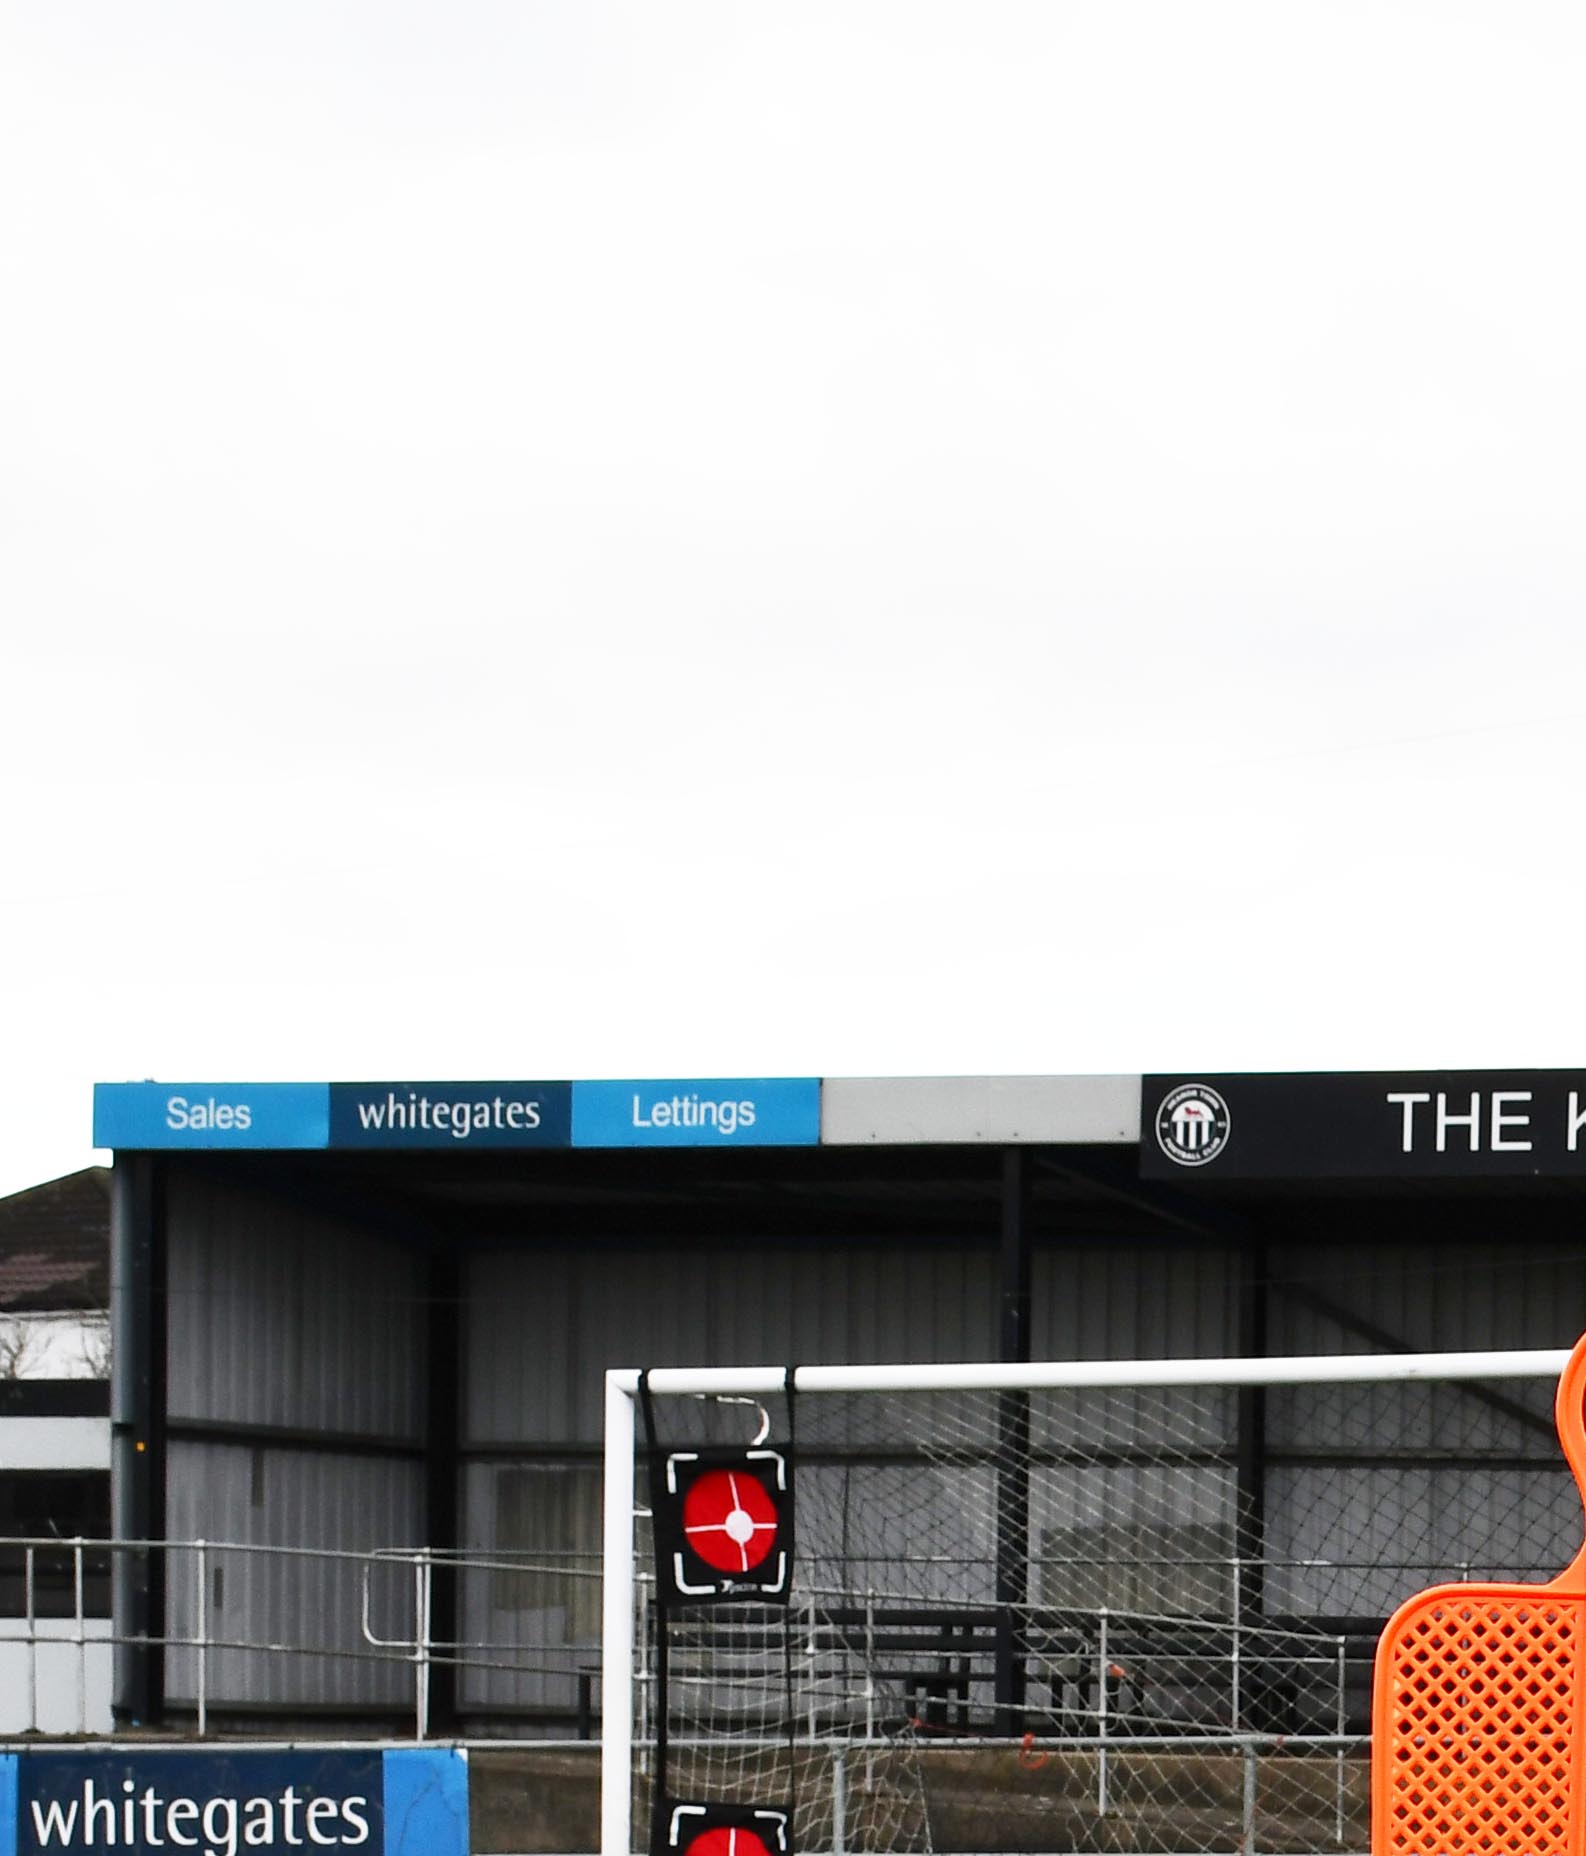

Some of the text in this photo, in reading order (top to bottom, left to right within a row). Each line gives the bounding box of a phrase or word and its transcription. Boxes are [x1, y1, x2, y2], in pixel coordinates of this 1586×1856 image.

[165, 1095, 253, 1131] Sales
[357, 1092, 541, 1139] whitegates
[631, 1094, 757, 1136] Lettings
[1386, 1091, 1533, 1152] THE
